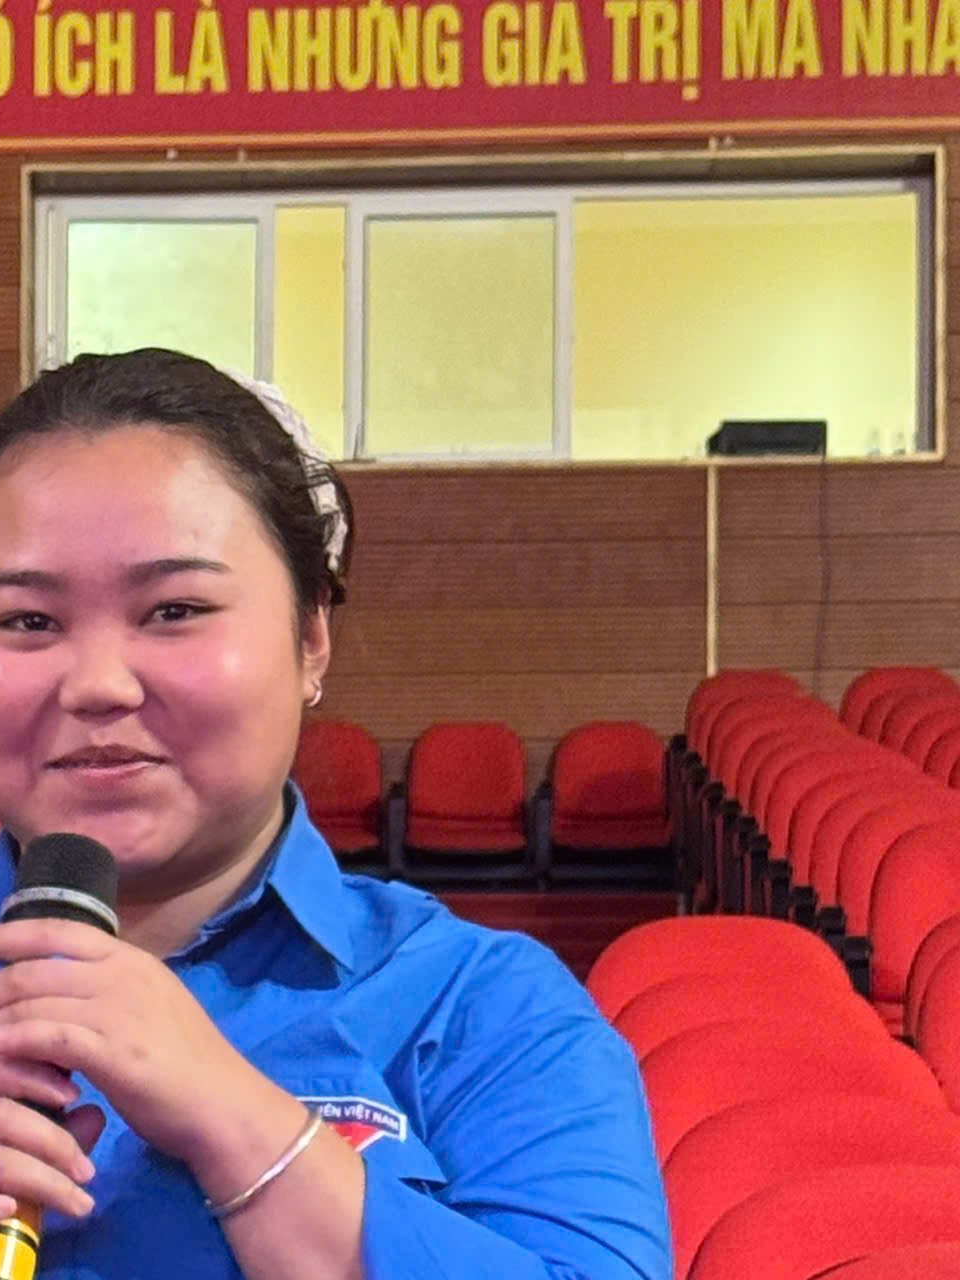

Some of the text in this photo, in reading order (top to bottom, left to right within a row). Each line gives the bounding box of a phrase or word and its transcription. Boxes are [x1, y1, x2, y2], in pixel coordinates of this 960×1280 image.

[33, 0, 136, 98] ÍCH
[603, 0, 700, 101] TRỊ
[343, 1103, 371, 1120] VIỆT
[372, 1111, 400, 1131] NAM
